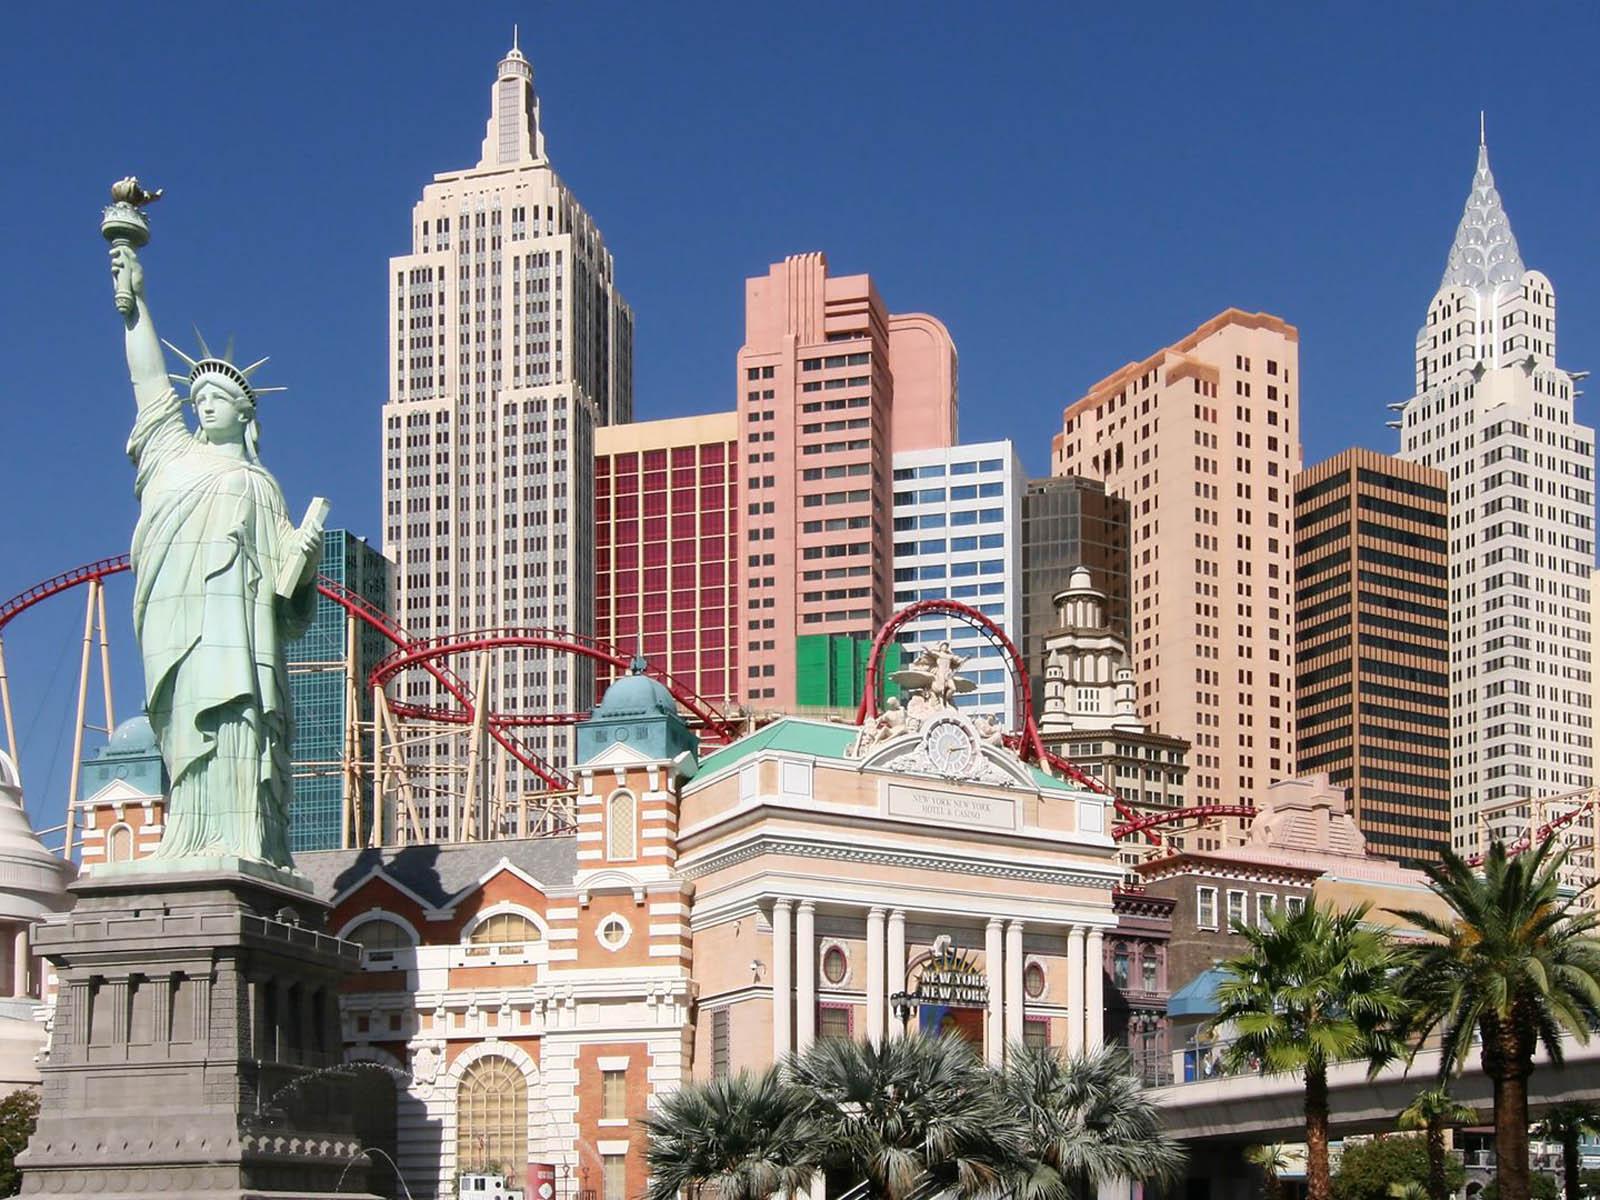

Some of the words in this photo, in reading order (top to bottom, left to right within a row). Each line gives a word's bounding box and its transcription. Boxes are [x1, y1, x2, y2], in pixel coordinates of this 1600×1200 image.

[912, 794, 929, 803] NEW
[931, 797, 951, 807] YORK
[954, 799, 969, 808] NEW
[971, 801, 991, 812] YORK
[921, 805, 944, 815] HOTEL
[954, 809, 982, 819] CASINO
[922, 971, 951, 984] NEW
[955, 974, 988, 987] YORK
[922, 985, 951, 999] NEW
[955, 987, 988, 1002] YORK
